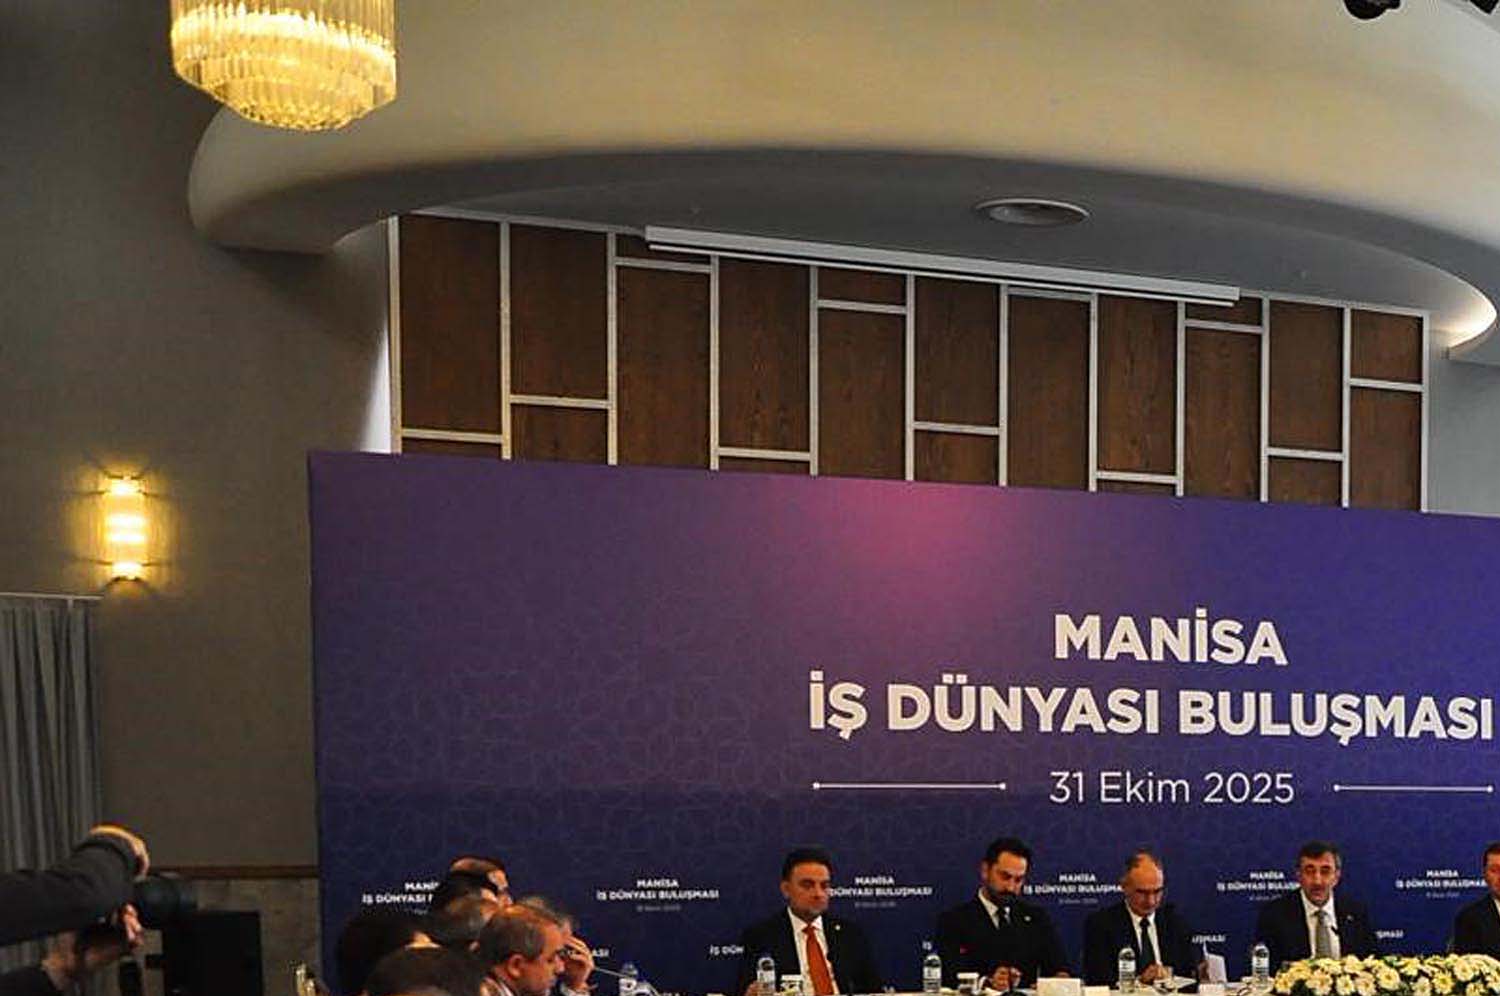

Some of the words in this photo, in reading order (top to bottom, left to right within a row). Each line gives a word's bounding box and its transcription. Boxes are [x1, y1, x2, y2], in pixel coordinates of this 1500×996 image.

[1055, 607, 1289, 666] MANİSA
[809, 670, 868, 741] İŞ
[887, 673, 1159, 734] DÜNYASI
[1179, 690, 1493, 747] BULUŞMASI
[1049, 771, 1084, 803] 31
[1100, 770, 1190, 803] Ekim
[1203, 772, 1294, 804] 2025
